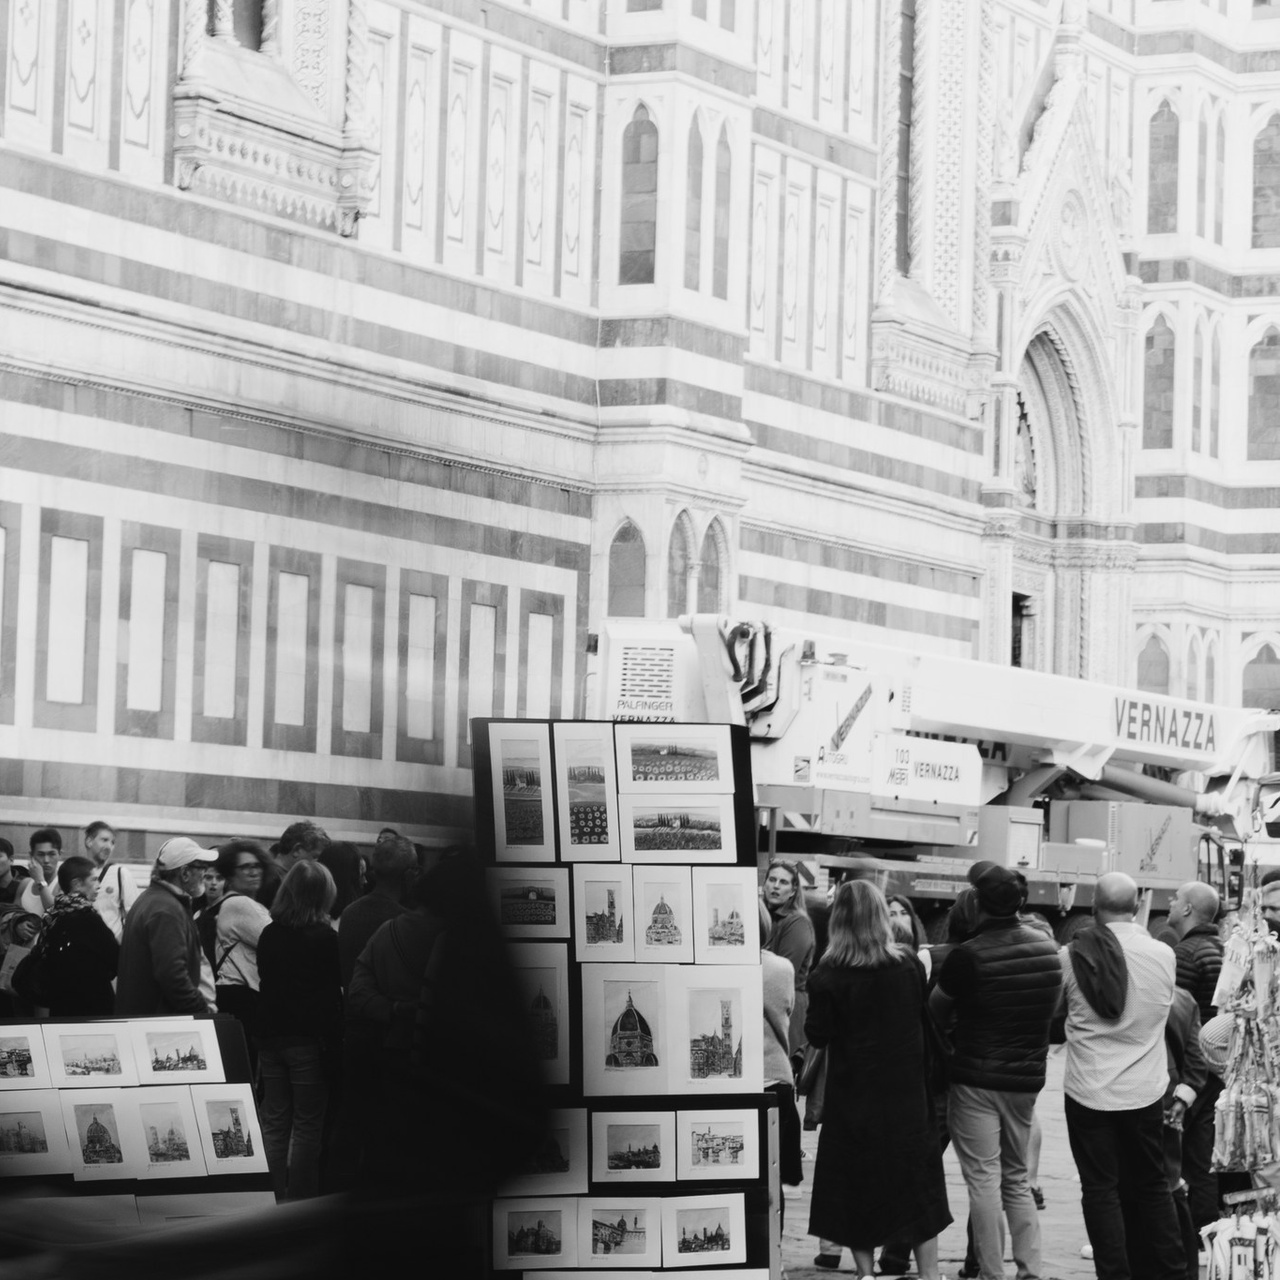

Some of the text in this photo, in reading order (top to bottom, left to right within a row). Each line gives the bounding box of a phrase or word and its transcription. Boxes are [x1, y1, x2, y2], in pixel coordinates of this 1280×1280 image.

[616, 699, 673, 711] PALFINGER
[1115, 696, 1216, 752] VERNAZZA
[895, 748, 910, 764] 103
[914, 761, 960, 782] VERNAZZA
